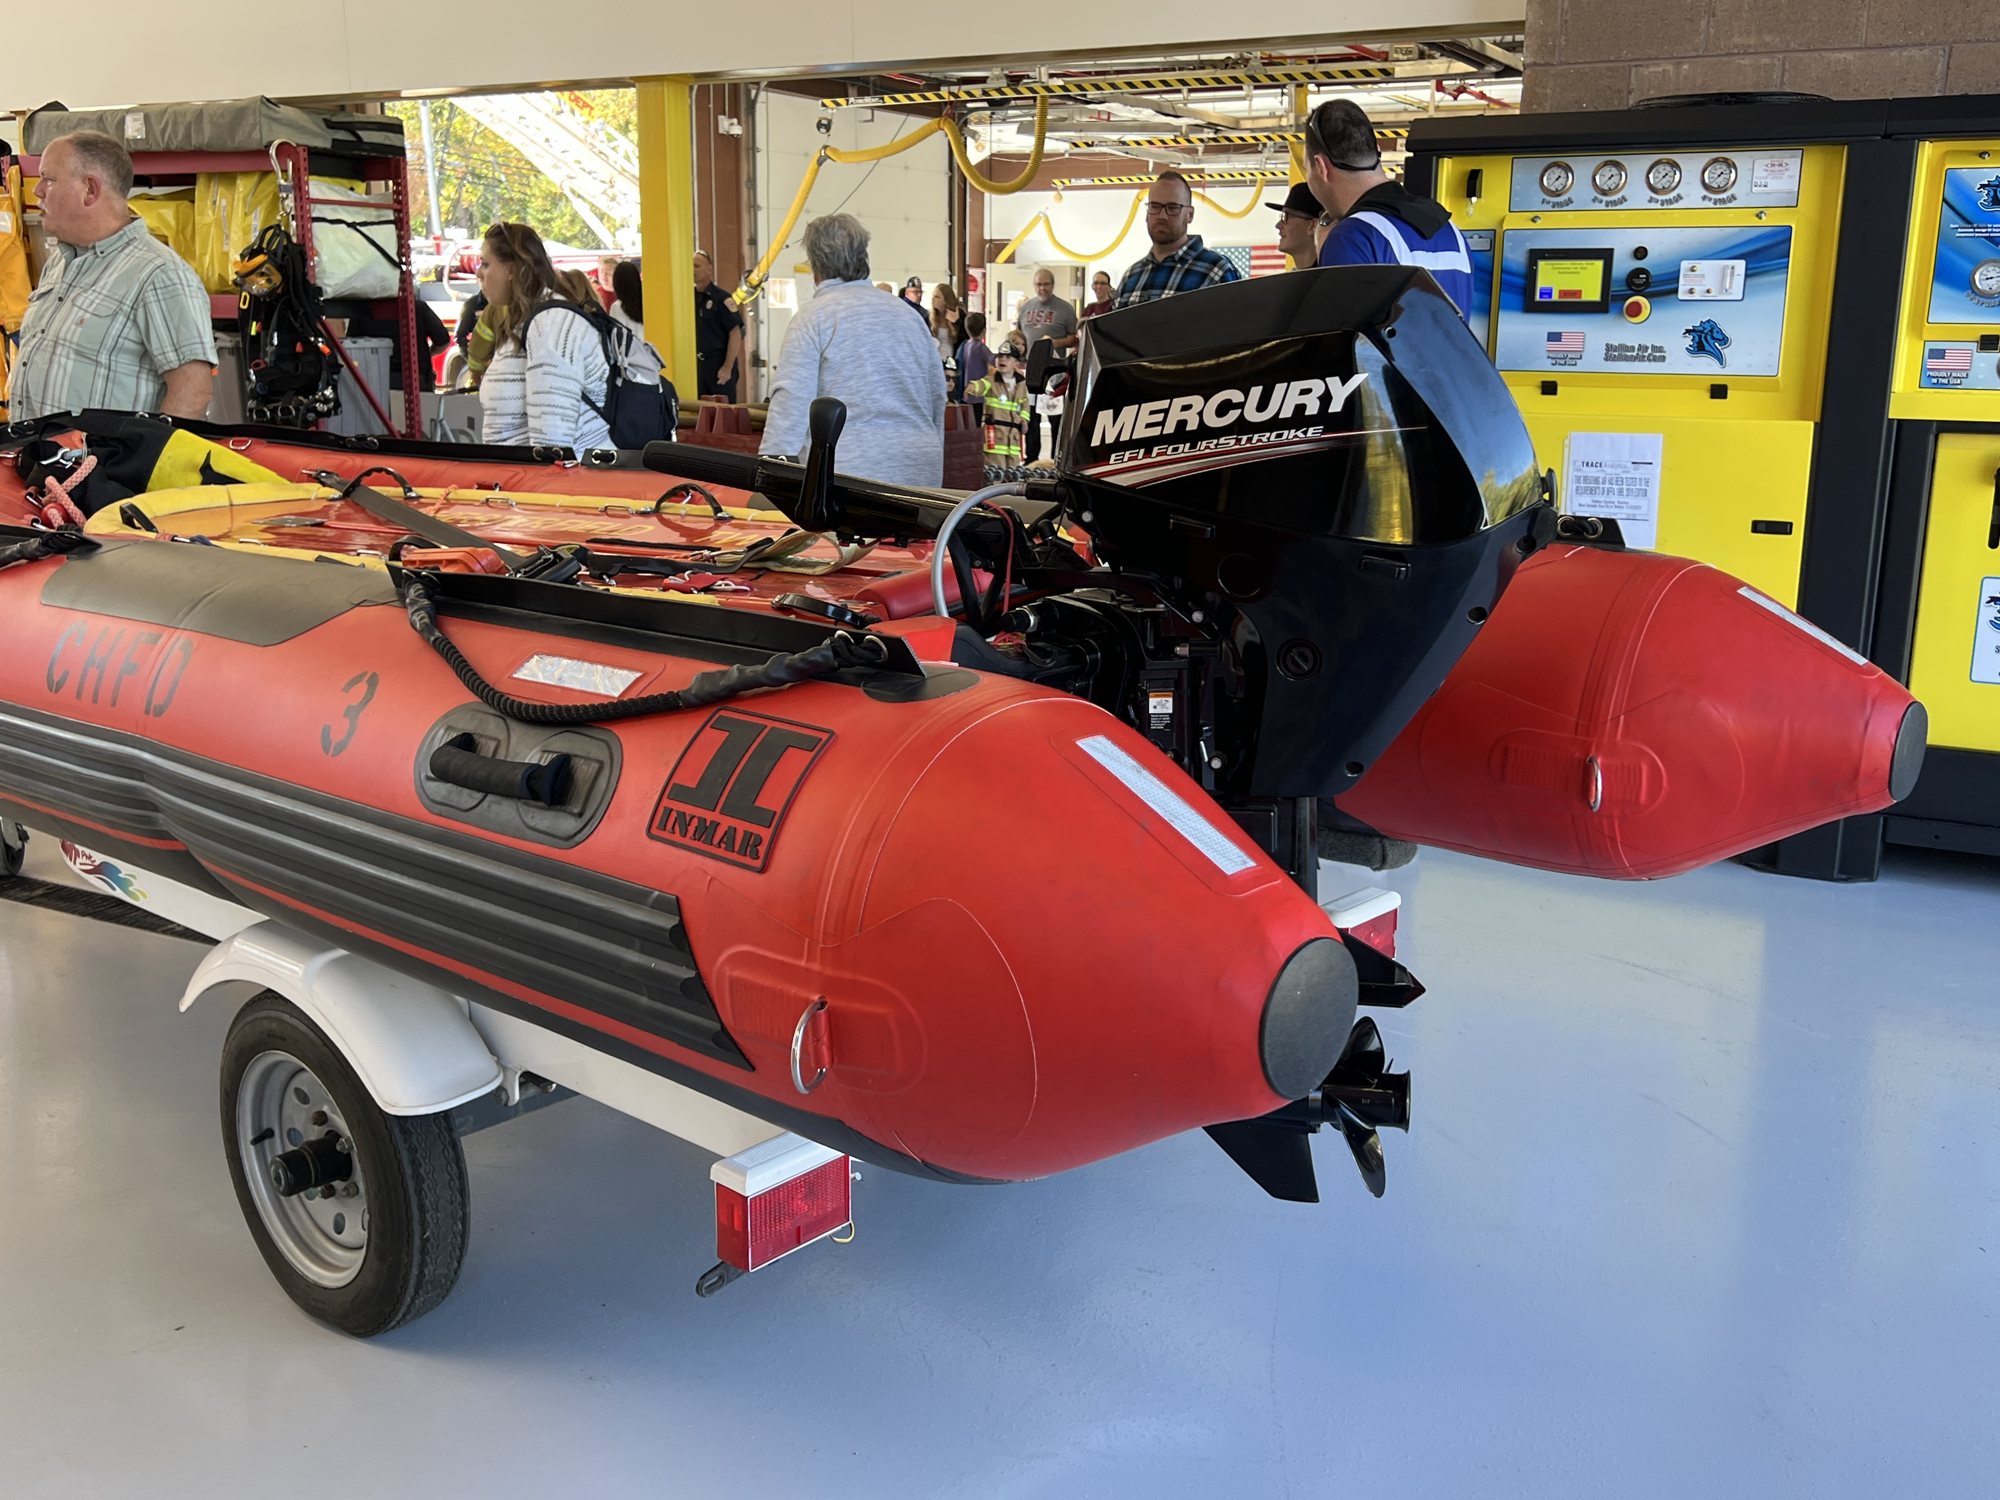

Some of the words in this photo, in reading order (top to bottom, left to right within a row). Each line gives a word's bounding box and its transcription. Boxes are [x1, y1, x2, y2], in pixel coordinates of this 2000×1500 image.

[1025, 310, 1055, 324] USA
[1090, 373, 1369, 447] MERCURY
[1109, 451, 1145, 465] EFI
[1151, 425, 1324, 458] FOURSTROKE
[46, 619, 194, 717] CHFD
[320, 671, 380, 757] 3
[656, 806, 763, 860] INMAR
